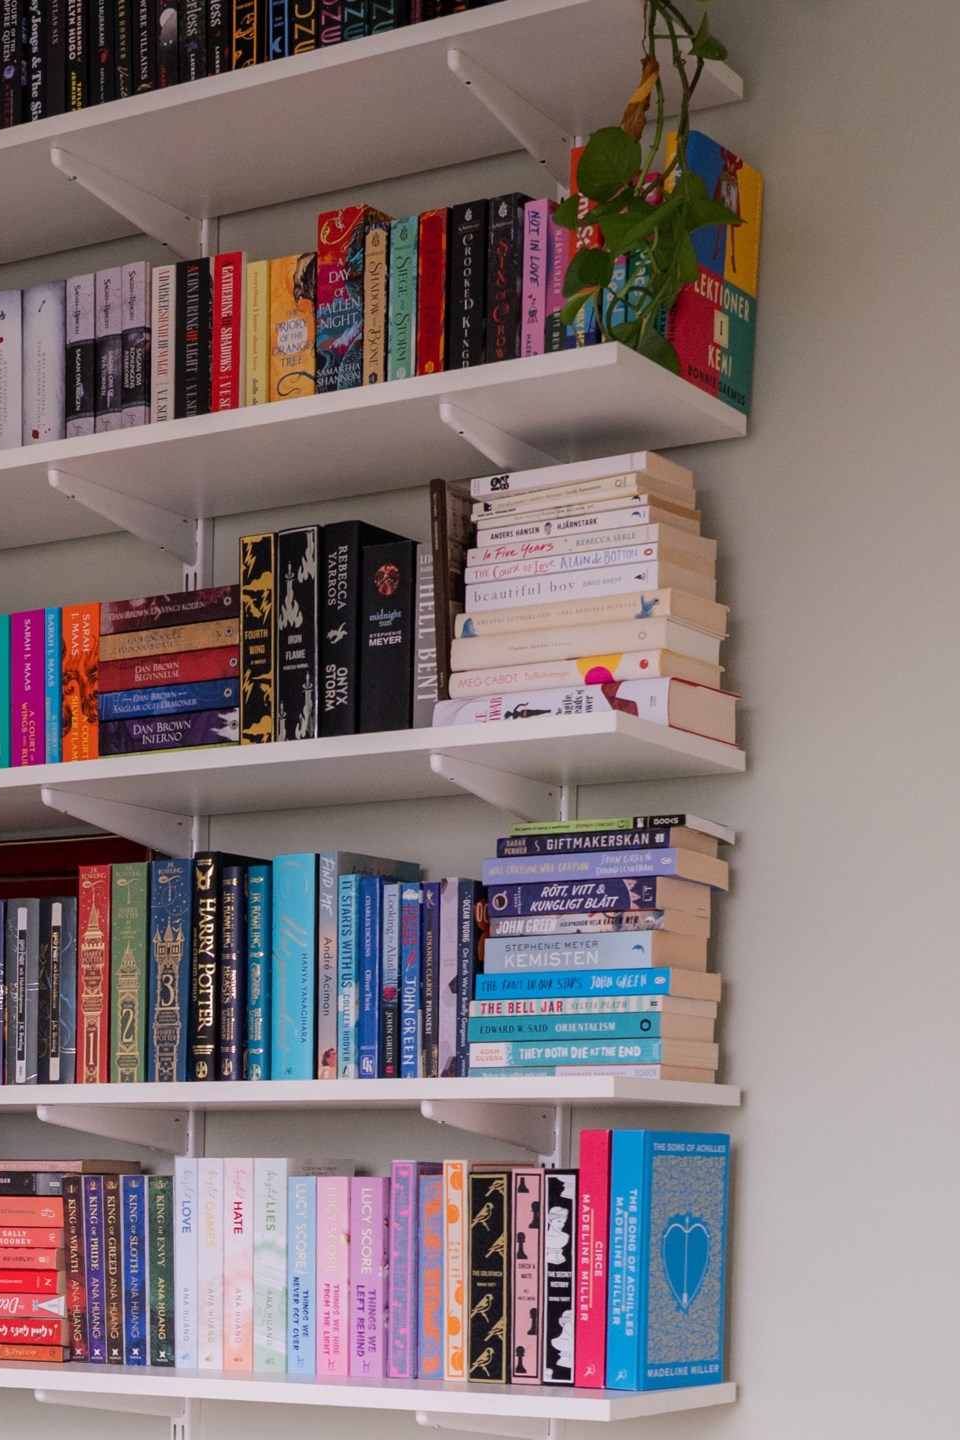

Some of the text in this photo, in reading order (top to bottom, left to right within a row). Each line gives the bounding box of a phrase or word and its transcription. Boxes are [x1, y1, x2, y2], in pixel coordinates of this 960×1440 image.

[68, 30, 76, 60] HUGO
[140, 30, 149, 80] VILLAINS
[528, 210, 541, 287] NOT IN LOVE
[328, 269, 350, 284] DAY
[462, 233, 474, 311] CROOKED
[319, 296, 361, 313] FALLEN
[395, 256, 411, 362] SIEGE STORM
[694, 272, 750, 323] LEKTIONER
[320, 312, 358, 329] NIGHT
[368, 261, 382, 368] SHADOW BONE
[708, 346, 732, 378] KEMI
[687, 365, 746, 408] BONNIE GARMUS
[490, 518, 598, 541] ANDERS HANSEN HJÄRNSTARK
[495, 547, 518, 559] Five
[521, 542, 554, 555] Years
[576, 535, 611, 547] REBECCA
[612, 532, 636, 543] SERLE
[560, 549, 638, 569] ALAIN de BOTTON
[327, 551, 338, 606] YARROS
[338, 545, 349, 610] REBECCA
[474, 580, 576, 603] beautiful boy
[369, 608, 402, 622] midnight
[379, 619, 392, 627] sun
[24, 618, 32, 652] SARAH
[71, 622, 80, 656] MAAS
[82, 613, 90, 653] SARAH
[245, 629, 268, 641] FOURTH
[288, 634, 302, 645] IRON
[369, 630, 402, 638] STEPHENIE
[369, 635, 402, 647] MEYER
[249, 644, 265, 655] WING
[285, 649, 306, 661] FLAME
[325, 664, 336, 712] STORM
[336, 667, 349, 705] ONYX
[458, 673, 519, 689] MEG CABOT
[133, 720, 191, 736] DAN BROWN
[142, 732, 183, 745] INFERNO
[653, 817, 679, 826] BOOKS
[546, 833, 650, 850] GIFTMAKERSKAN
[530, 895, 619, 913] KUNGLIGT BLÅTT
[541, 883, 606, 899] RÖTT, VITT &
[321, 857, 336, 1016] FIND ME André Aciman
[341, 880, 353, 988] IT STARTS WITH US
[495, 917, 557, 935] JOHN GREEN
[504, 950, 599, 968] KEMISTEN
[505, 940, 599, 952] STEPHENIE MEYER
[198, 898, 216, 1031] HARRY POTTER
[161, 974, 174, 1007] 3
[402, 976, 417, 1066] JOHN GREEN
[480, 1000, 563, 1015] THE BELL JAR
[122, 1008, 134, 1043] 2
[480, 1026, 514, 1035] EDWARD
[528, 1024, 548, 1033] SAID
[555, 1022, 616, 1033] ORIENTALISM
[519, 1046, 641, 1060] THEY BOTH DIE AT THE END
[653, 1142, 726, 1153] THE SONG OF ACHILLES
[181, 1201, 191, 1233] LOVE
[233, 1201, 243, 1235] HATE
[361, 1188, 372, 1275] LUCY SCORE
[580, 1194, 590, 1322] MADELINE MILLER
[594, 1240, 603, 1277] CIRCE
[625, 1189, 638, 1337] THE SONG OF ACHILLES
[158, 1302, 167, 1340] HUANG
[355, 1285, 365, 1357] LEFT BEHIND
[368, 1289, 376, 1353] THINGS WE
[647, 1364, 720, 1378] MADELINE MILLER
